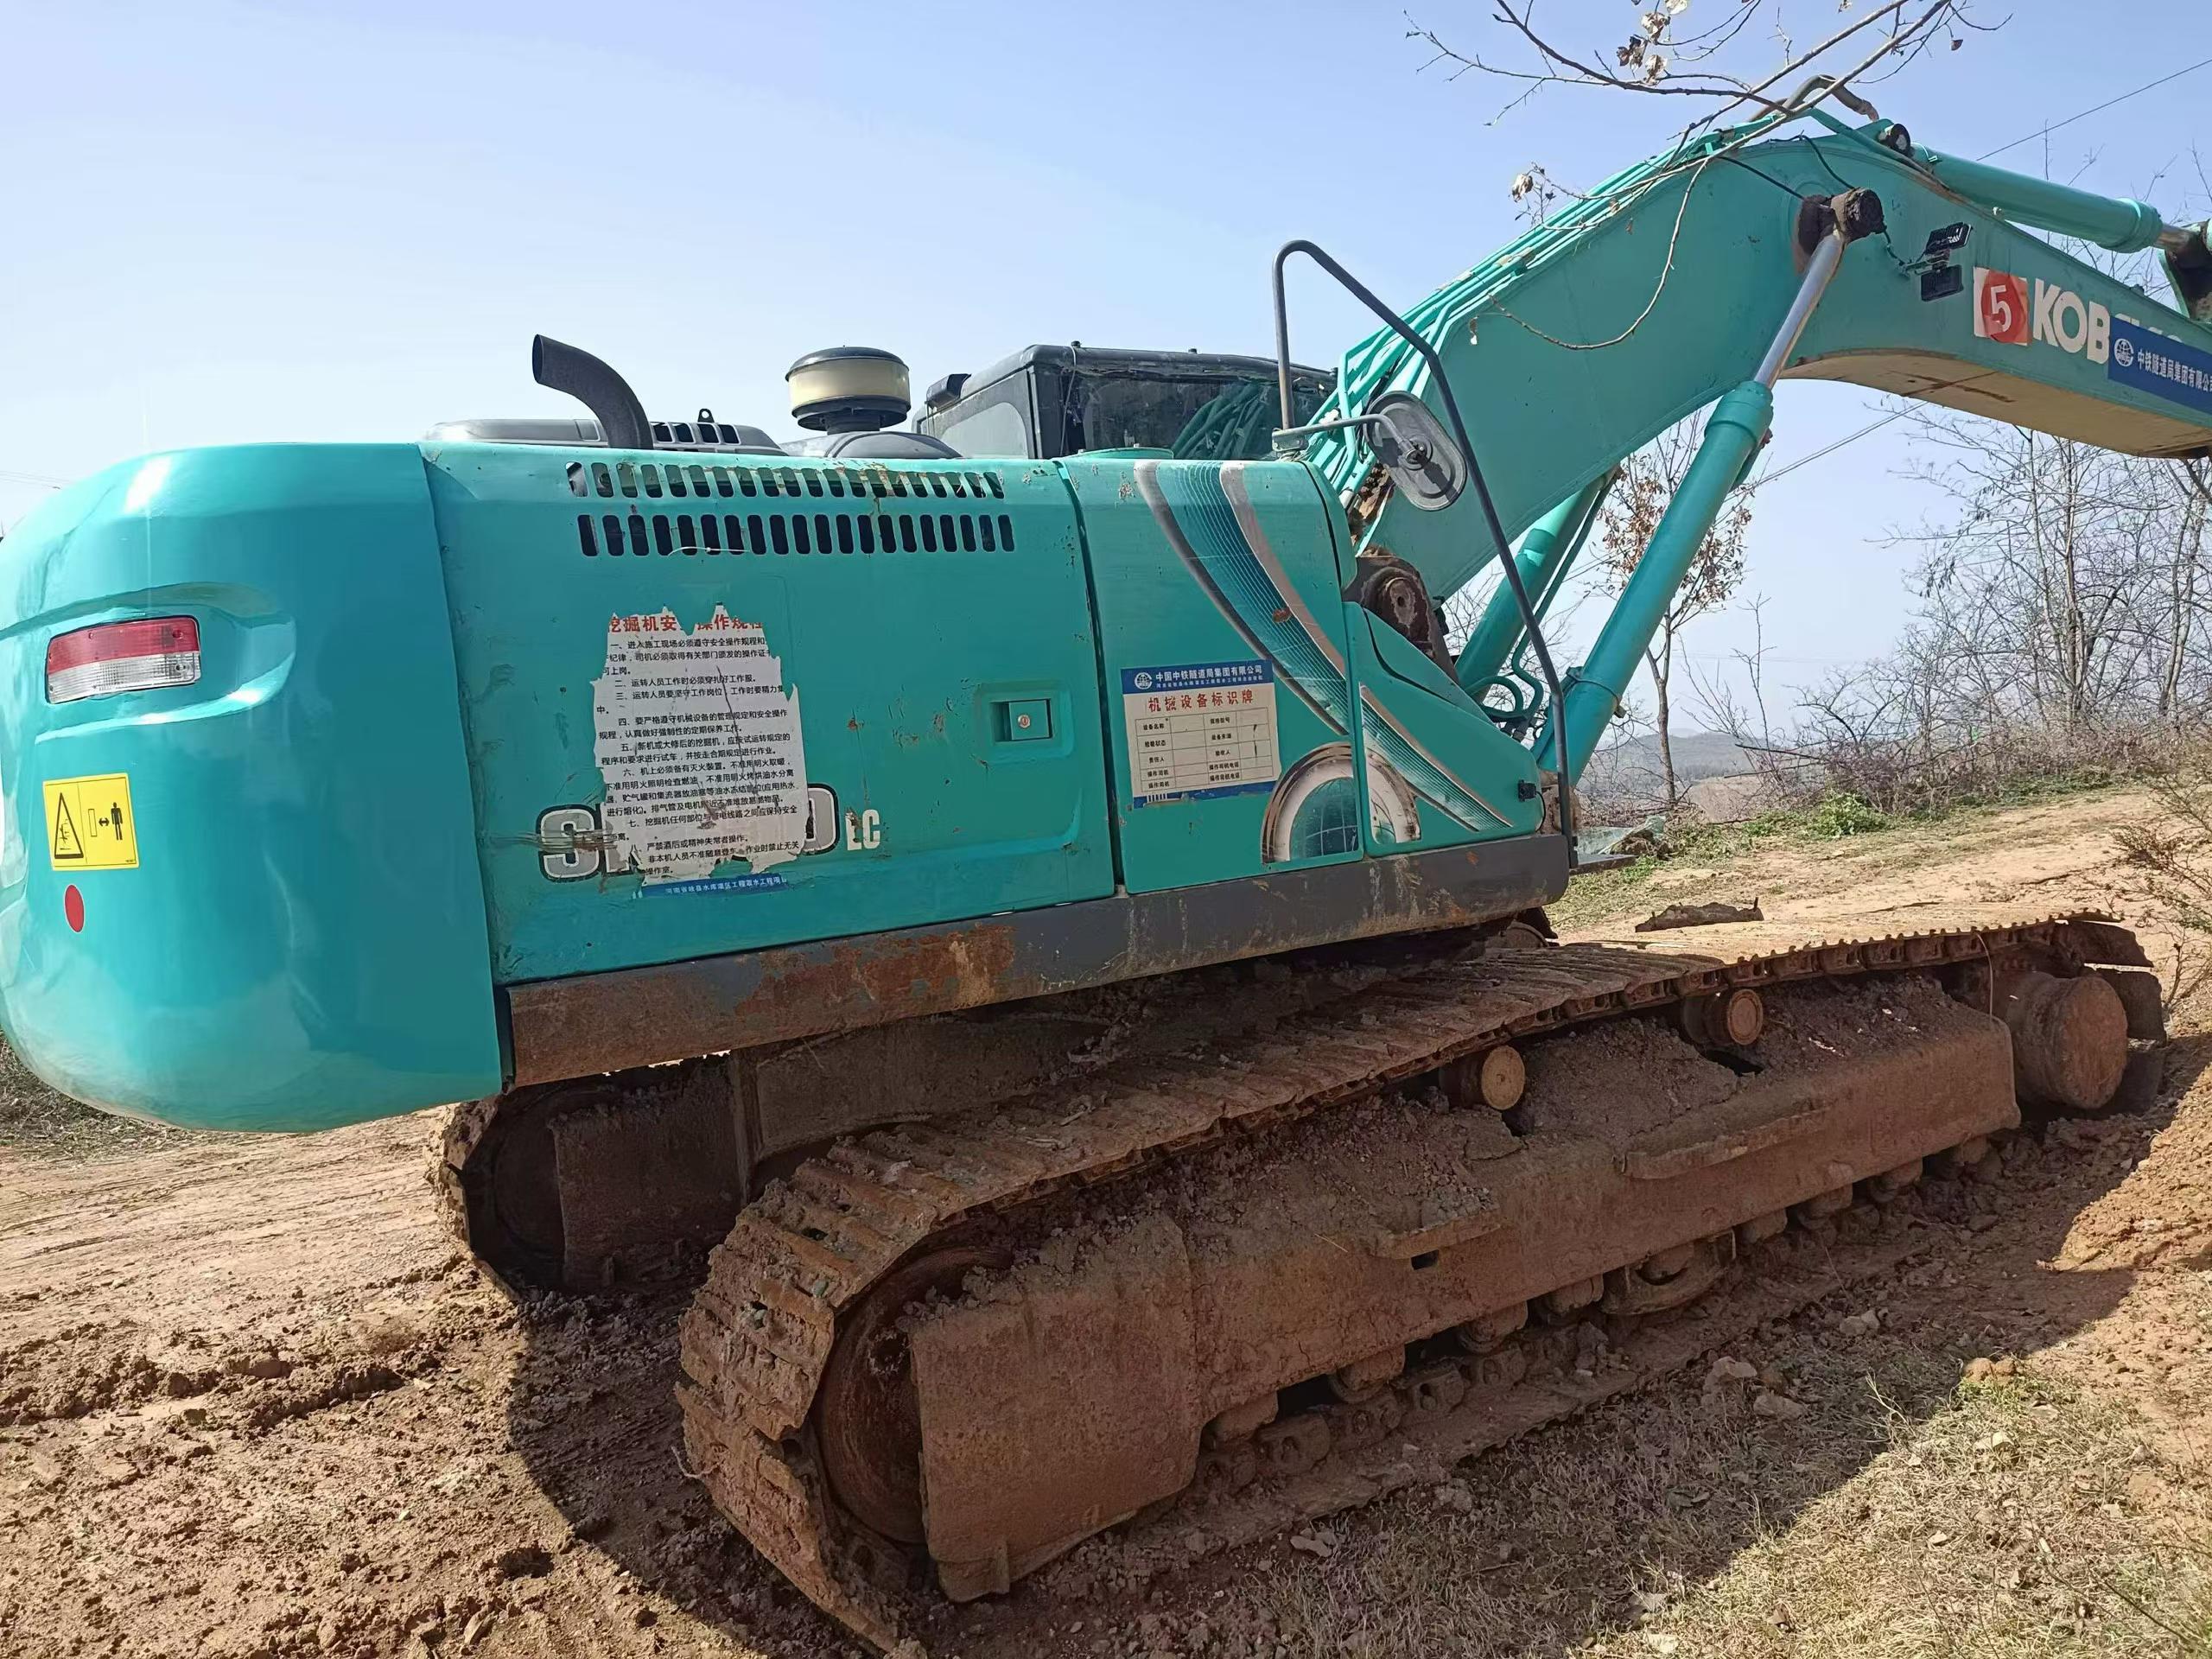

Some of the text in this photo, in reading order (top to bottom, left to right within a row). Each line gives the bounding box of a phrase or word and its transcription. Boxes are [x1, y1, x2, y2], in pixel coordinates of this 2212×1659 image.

[1990, 285, 2012, 333] 5
[1156, 664, 1262, 682] 中国中铁隧道局集团有限公司
[1148, 690, 1253, 713] 机械设备标识牌
[847, 809, 881, 851] LC
